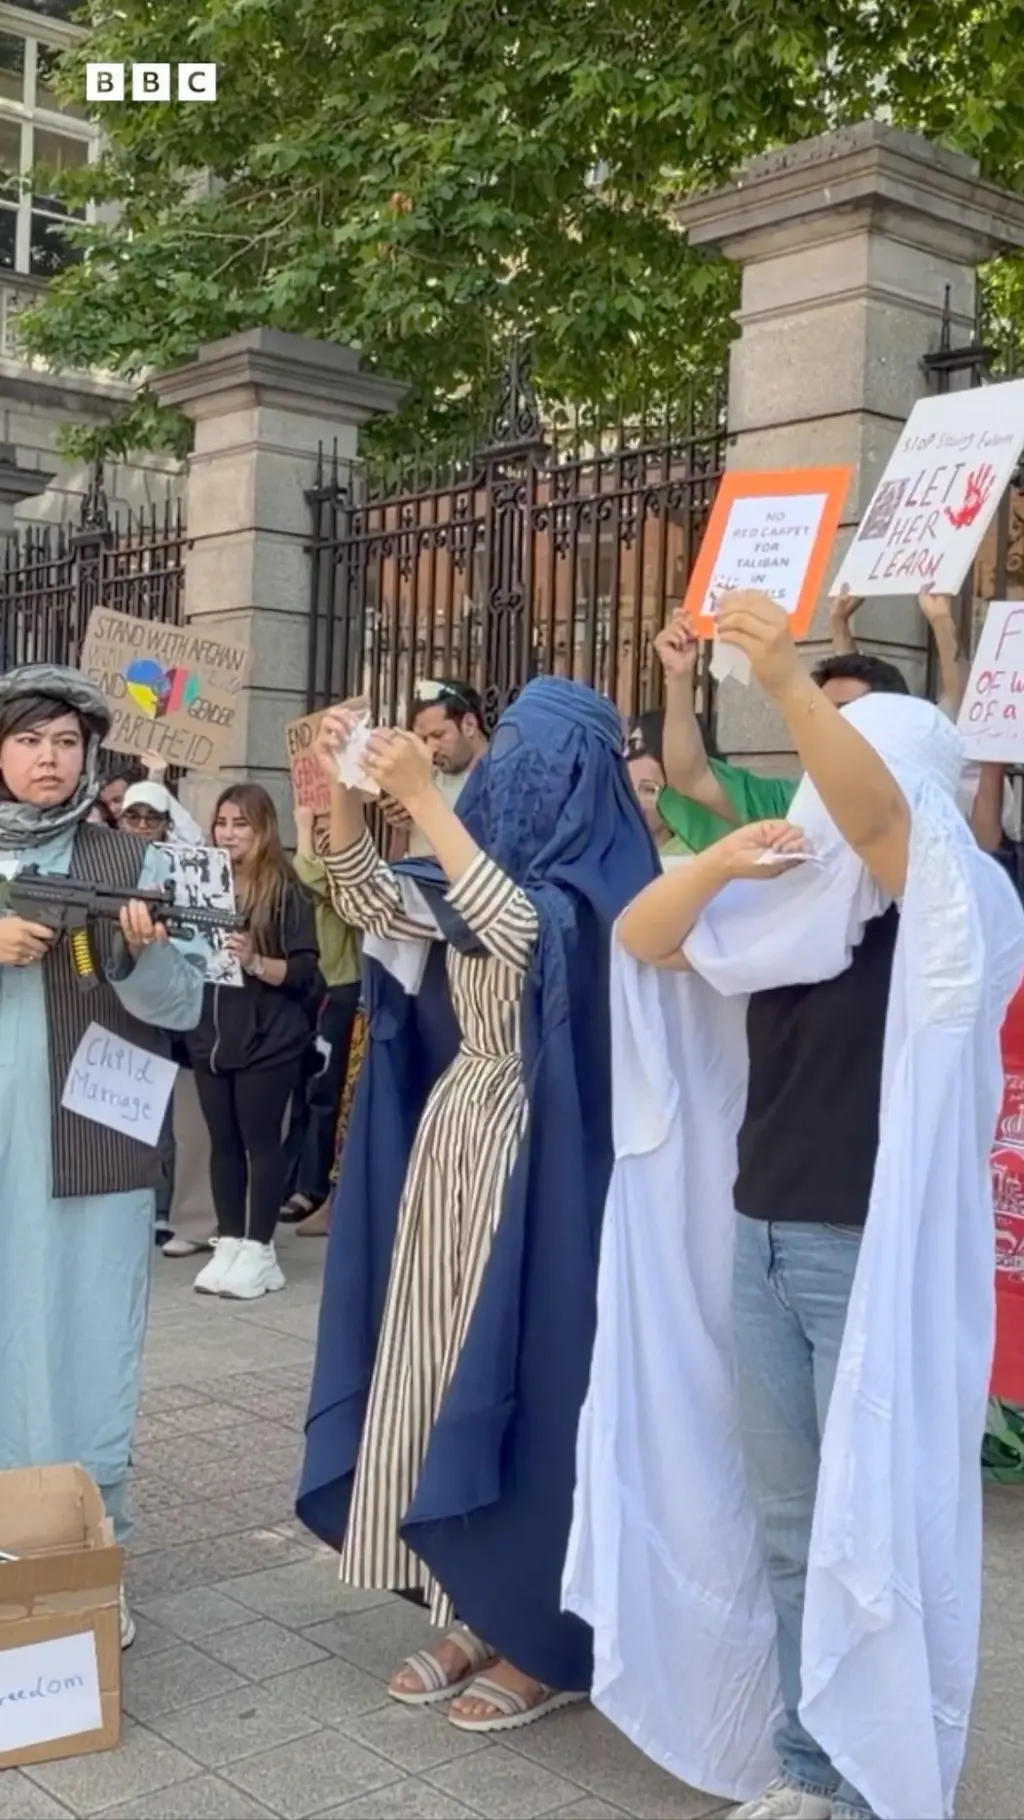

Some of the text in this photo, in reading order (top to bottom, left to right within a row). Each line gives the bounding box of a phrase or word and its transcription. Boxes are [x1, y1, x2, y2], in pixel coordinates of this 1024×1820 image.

[905, 462, 966, 507] LET
[765, 512, 786, 521] NO
[887, 509, 939, 547] HER
[736, 556, 790, 569] TALIBAN
[754, 542, 780, 553] FOR
[868, 547, 944, 580] LEARN
[750, 574, 766, 584] IN
[94, 616, 145, 647] STAND
[146, 629, 189, 661] WITH
[187, 638, 248, 672] AFGHAN
[87, 667, 128, 699] END
[975, 670, 1006, 696] OF
[188, 696, 236, 728] GENDER
[968, 700, 998, 724] OF
[86, 1037, 155, 1085] Child
